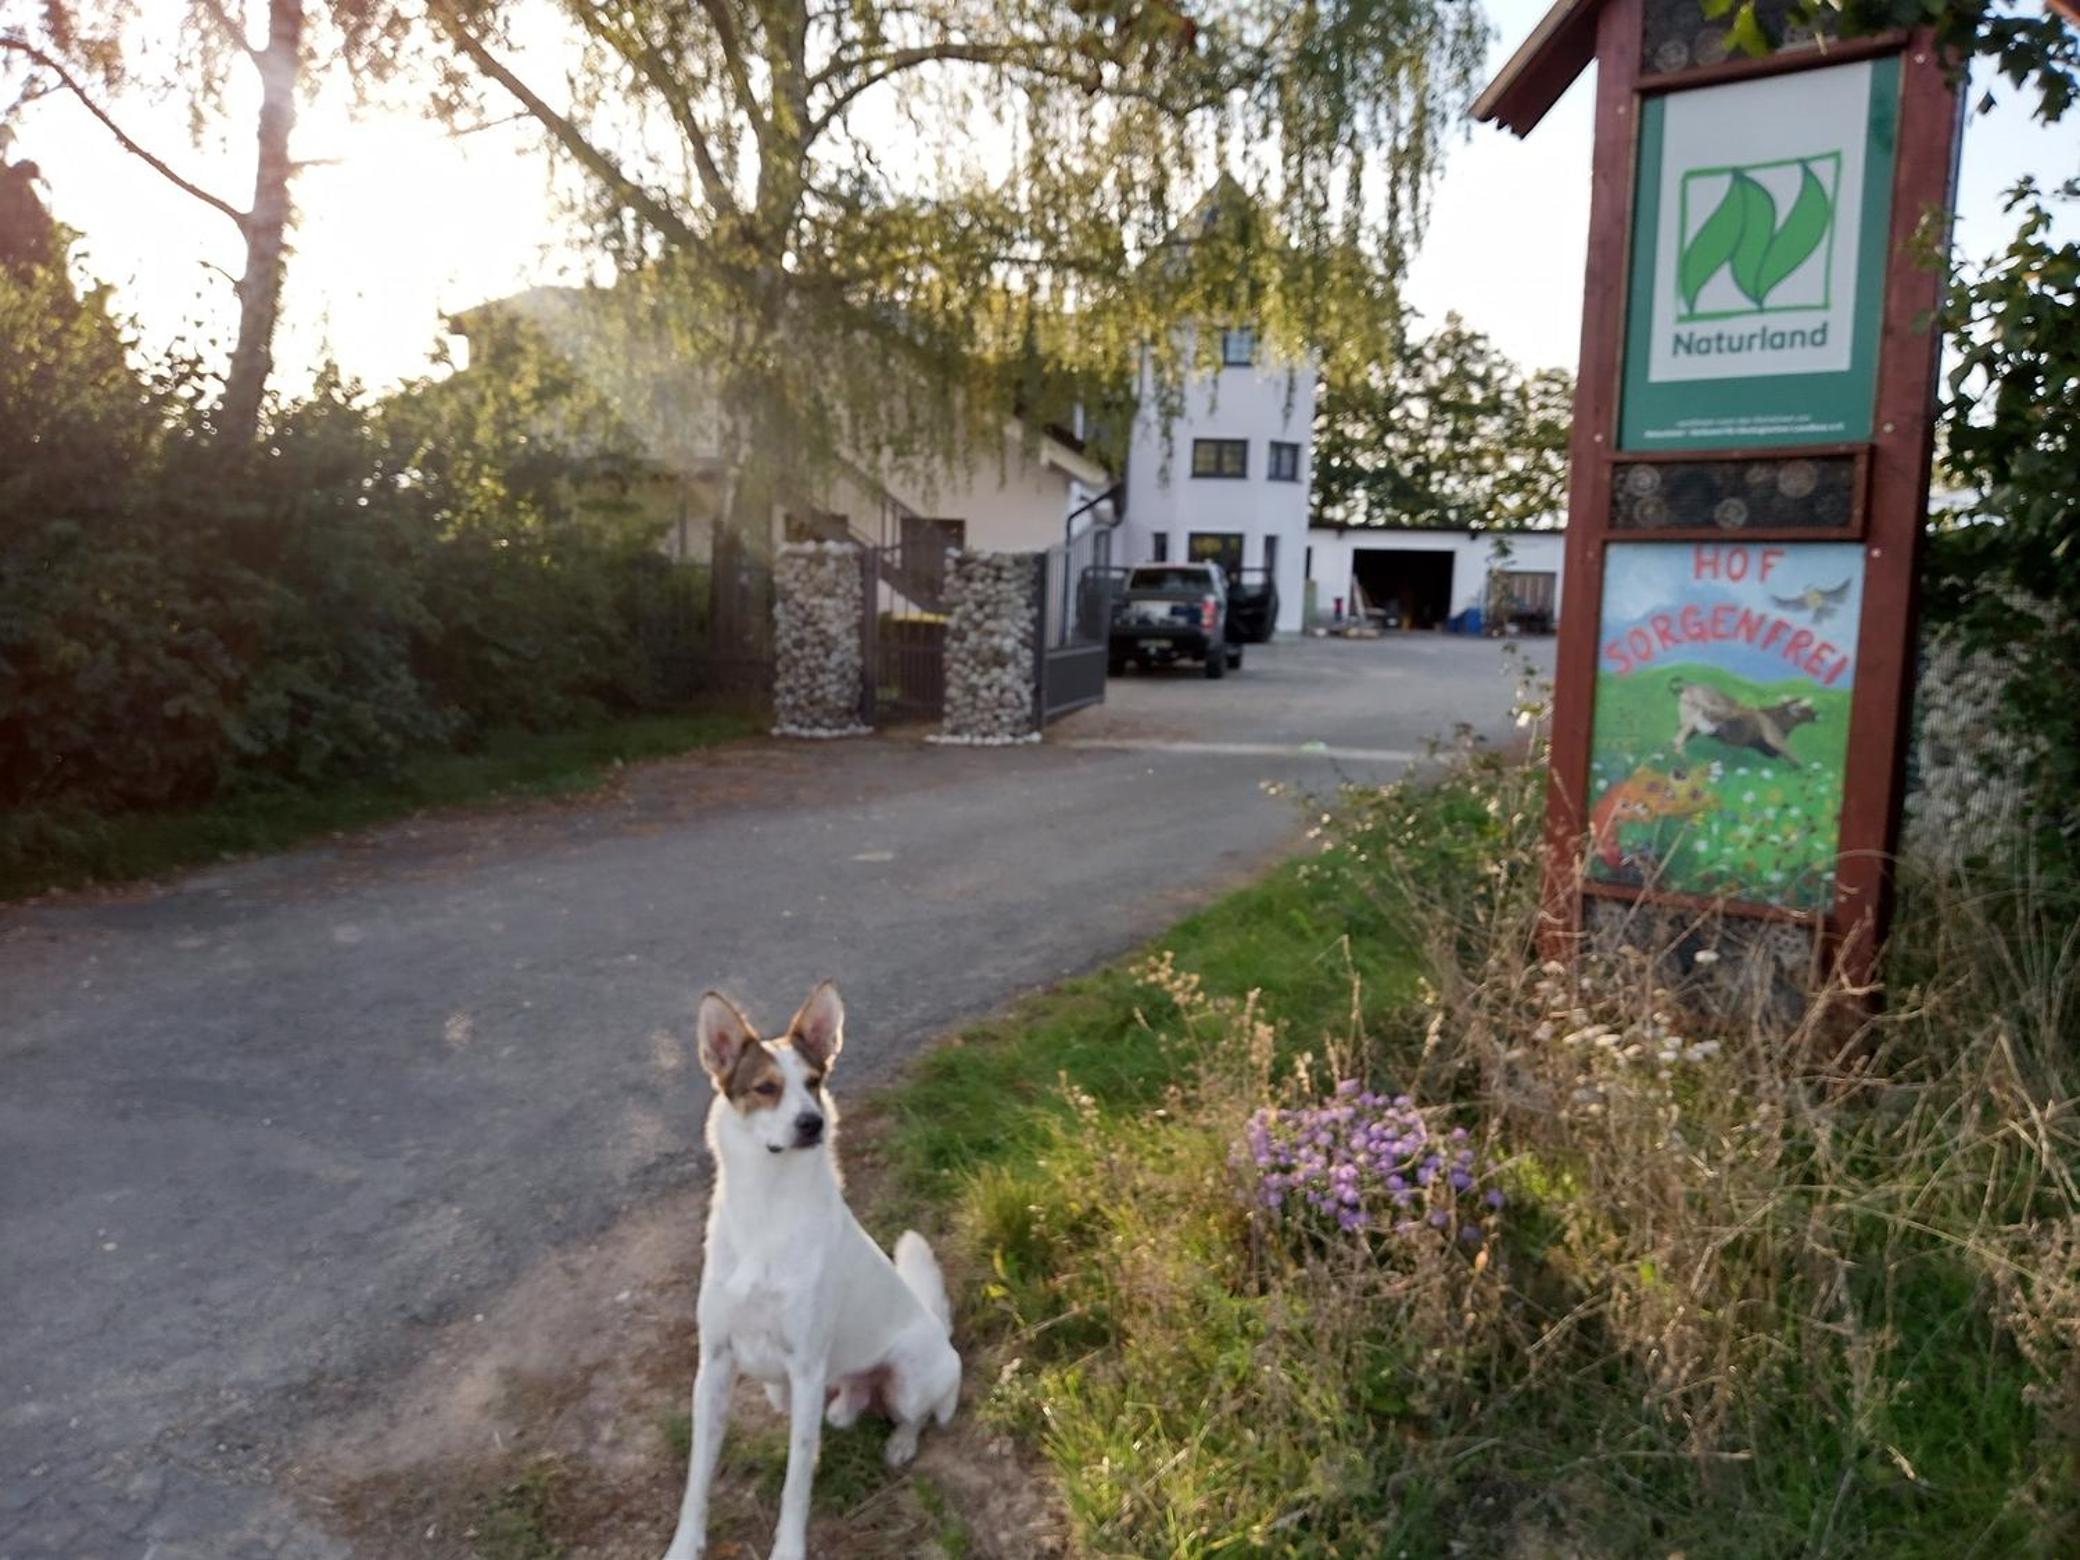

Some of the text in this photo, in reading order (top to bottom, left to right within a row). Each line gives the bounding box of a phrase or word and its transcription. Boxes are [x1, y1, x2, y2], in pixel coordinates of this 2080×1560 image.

[1672, 322, 1828, 357] Naturland
[1693, 544, 1785, 583] HOF
[1604, 604, 1848, 685] SORGENFREI
